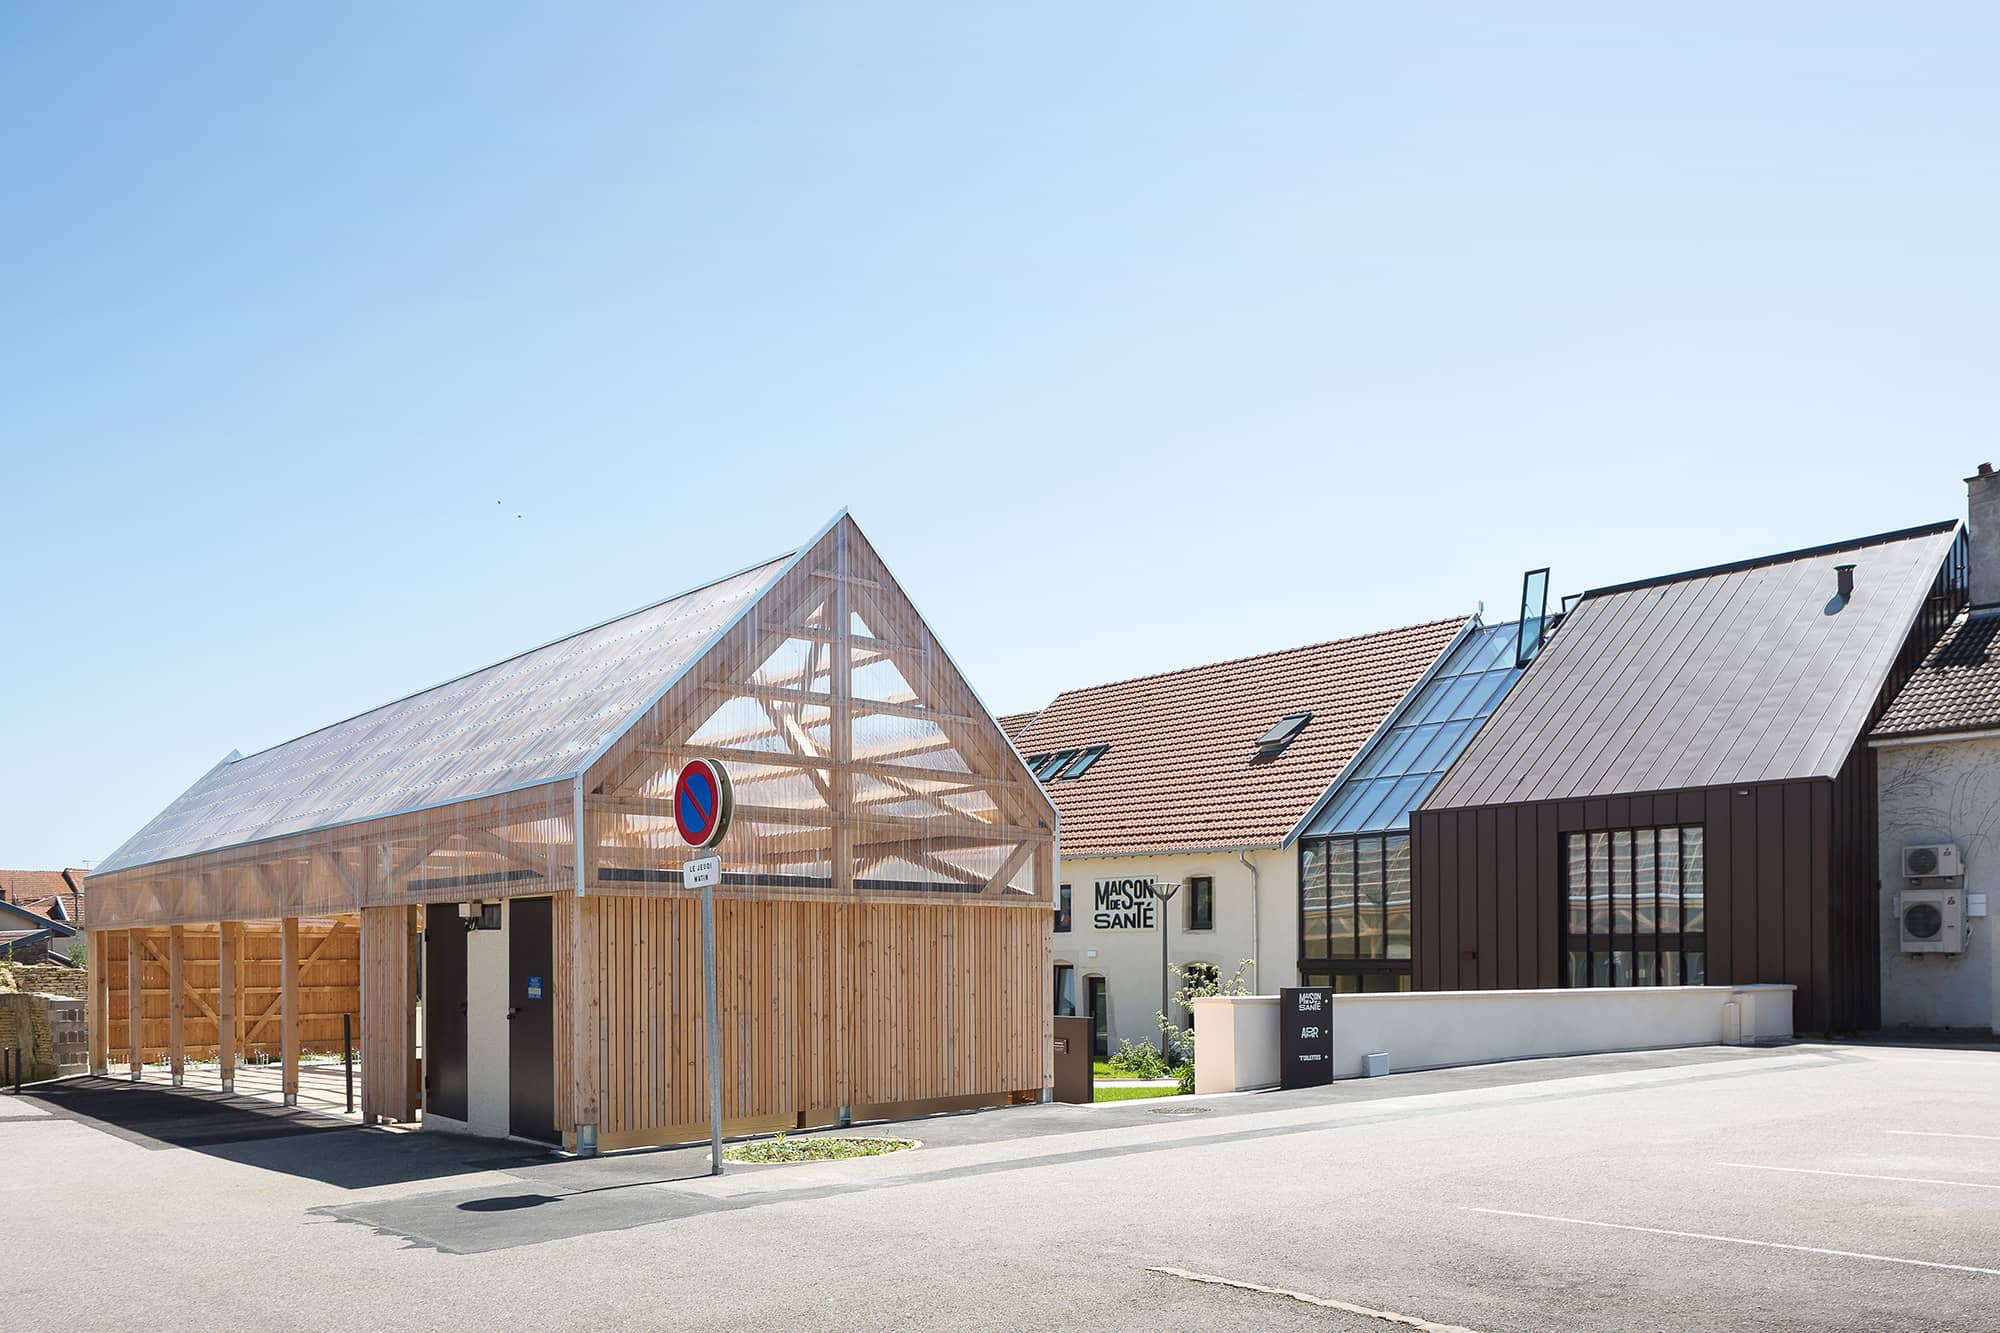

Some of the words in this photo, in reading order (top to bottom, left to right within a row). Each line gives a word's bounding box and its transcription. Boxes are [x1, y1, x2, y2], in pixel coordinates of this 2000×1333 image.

[1095, 879, 1153, 910] MAISON
[1110, 899, 1120, 910] DE
[1094, 902, 1153, 929] SANTÉ
